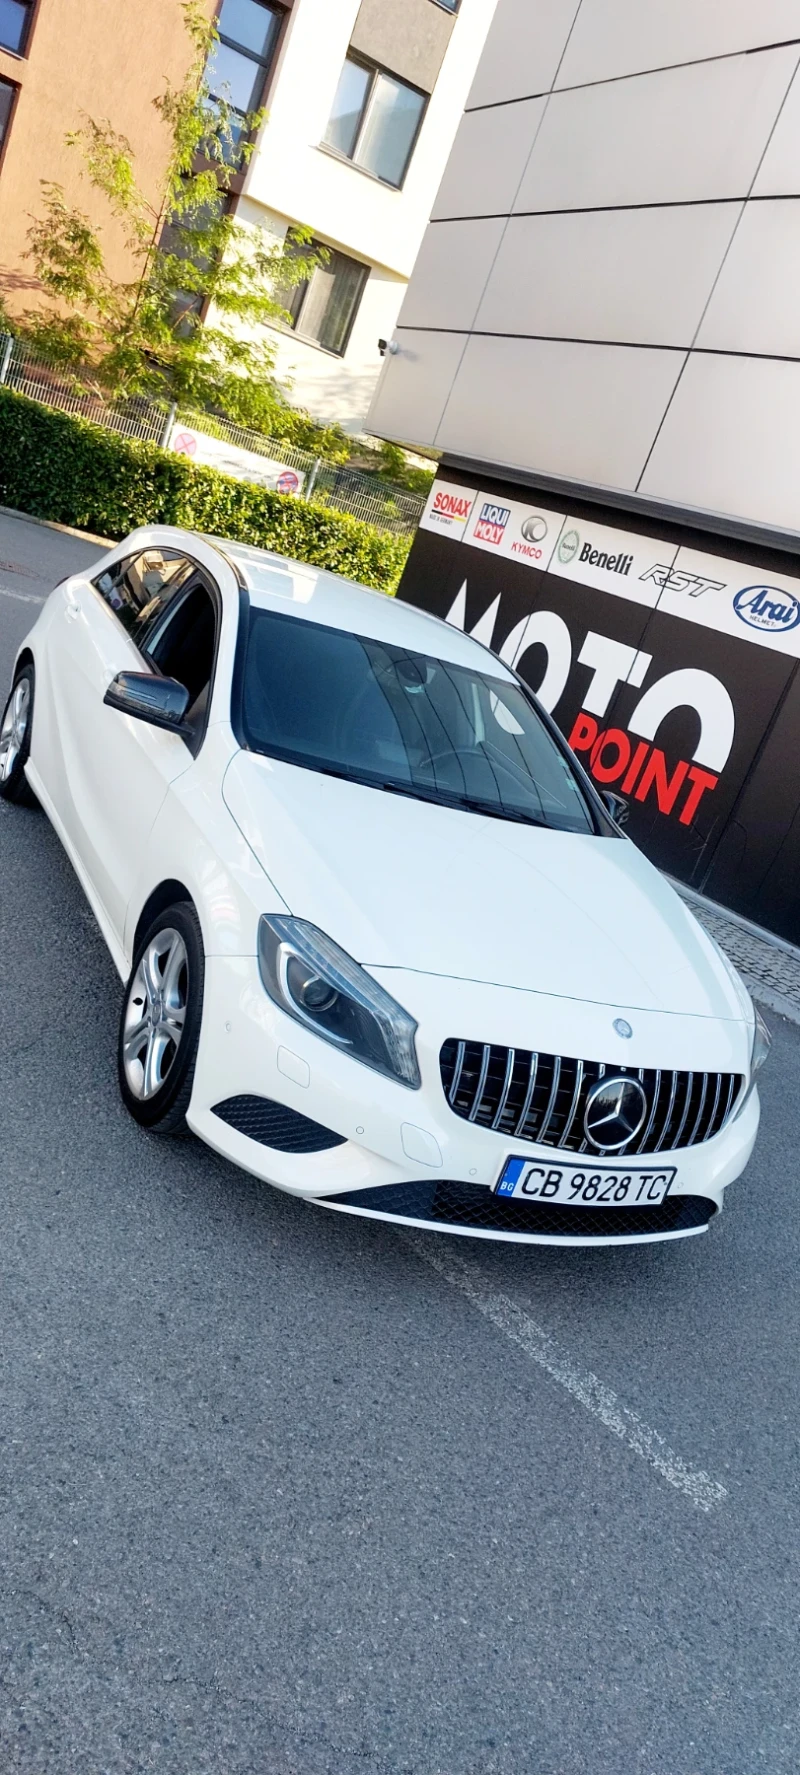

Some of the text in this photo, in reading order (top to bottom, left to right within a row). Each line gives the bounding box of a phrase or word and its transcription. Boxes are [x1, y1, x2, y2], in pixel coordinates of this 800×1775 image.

[433, 492, 472, 517] SONAX
[481, 504, 511, 526] LIQUI
[475, 524, 504, 544] MOLY
[511, 541, 542, 560] KYMCO
[578, 542, 634, 576] Benelli
[638, 563, 728, 598] RST
[735, 589, 798, 623] Arai
[567, 712, 719, 826] POINT
[500, 1181, 514, 1191] BG
[521, 1168, 667, 1202] CB 9828 TC
